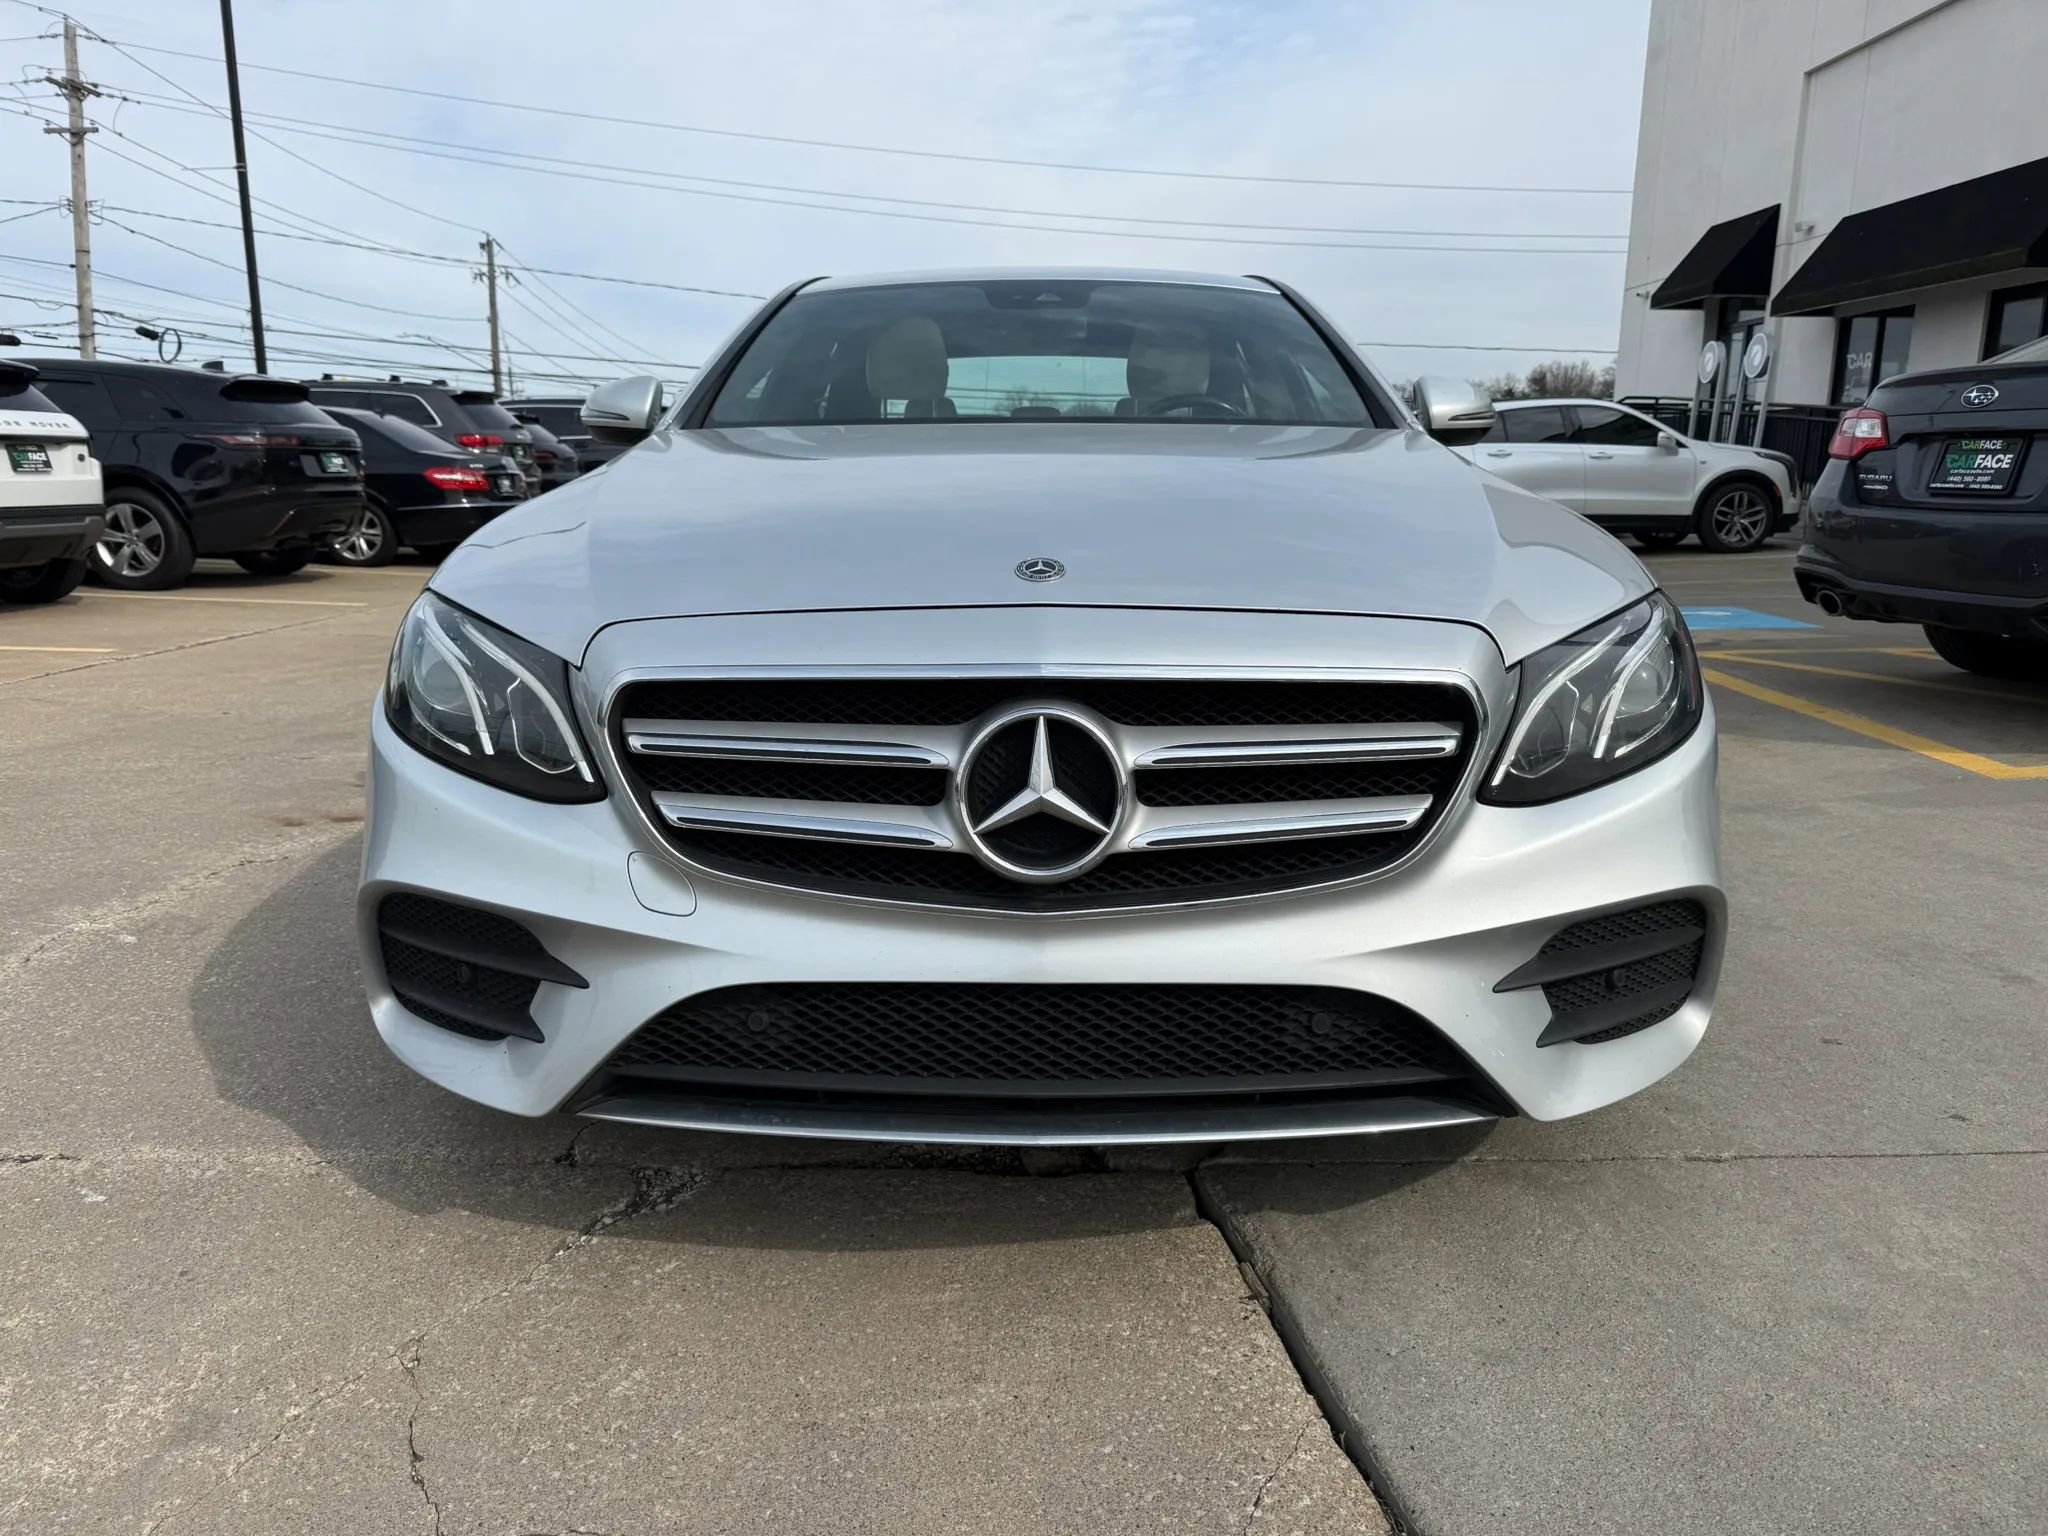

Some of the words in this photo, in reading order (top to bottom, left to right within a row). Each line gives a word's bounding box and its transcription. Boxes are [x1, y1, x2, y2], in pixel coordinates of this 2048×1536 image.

[1847, 352, 1873, 369] CAR
[1961, 440, 2003, 449] CARFACE
[1945, 453, 2014, 468] CARFACE
